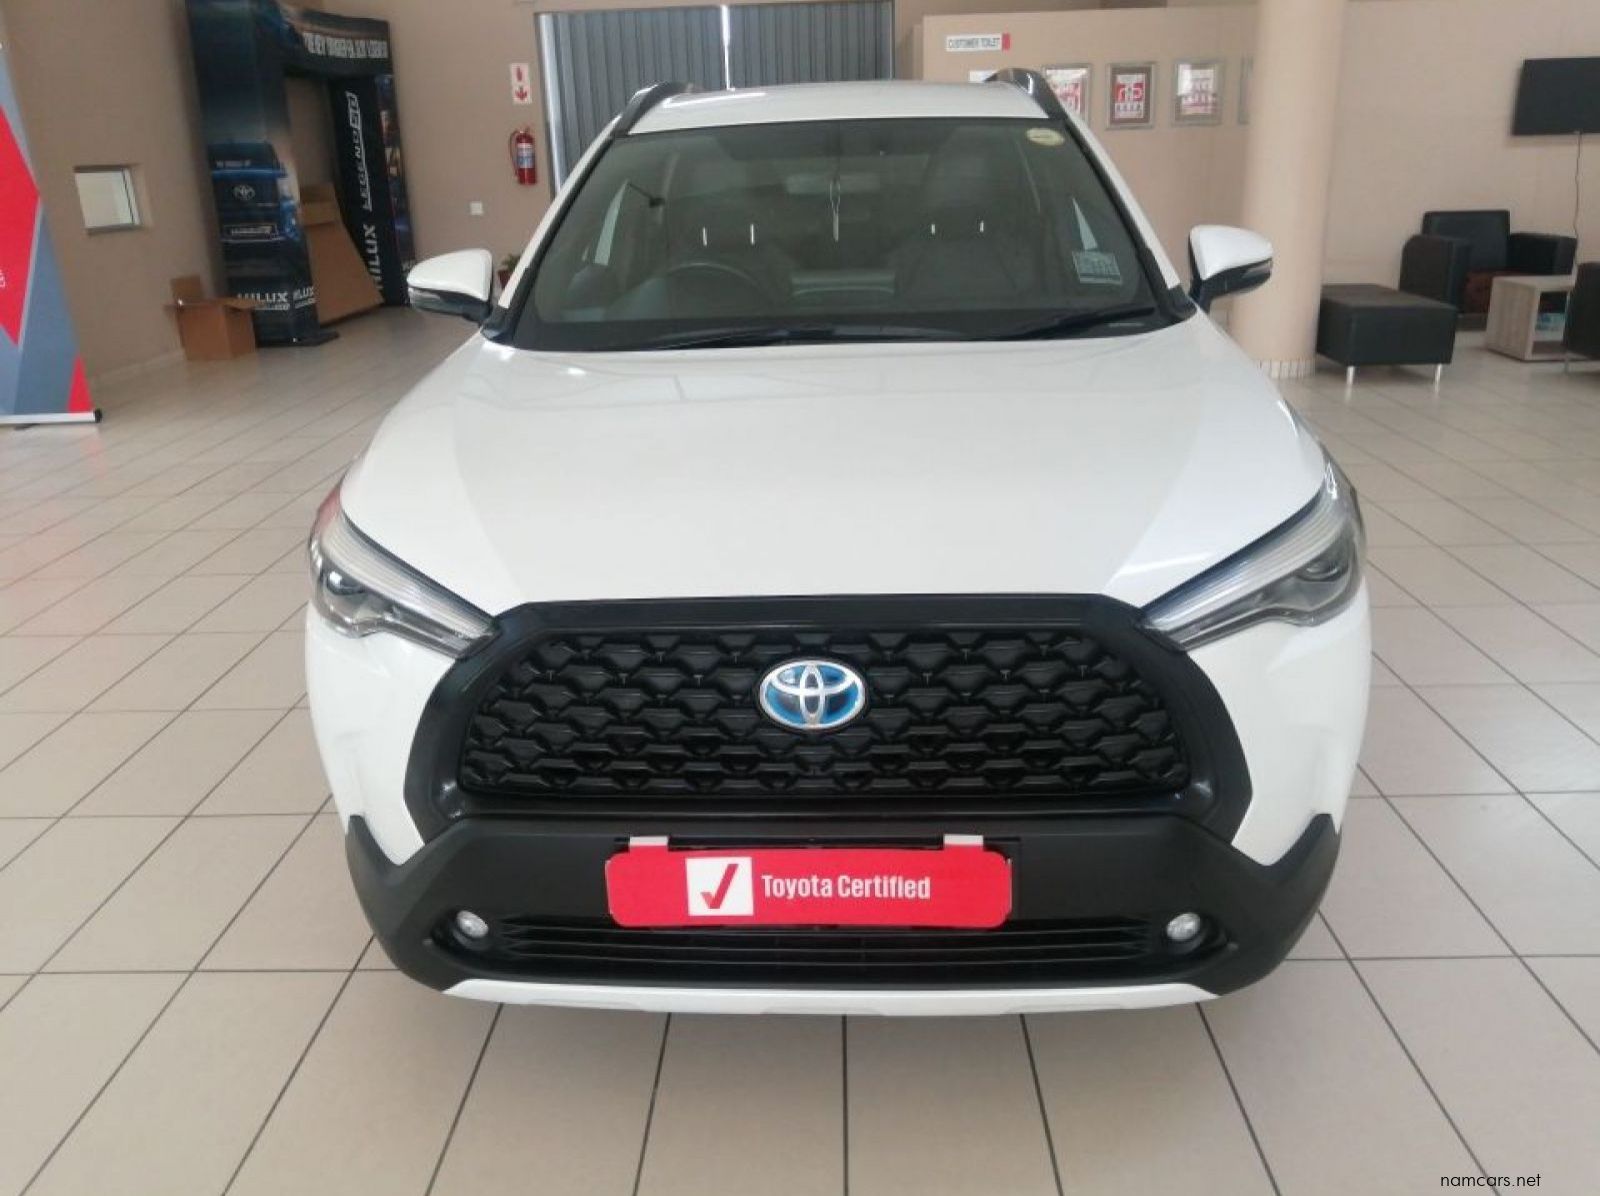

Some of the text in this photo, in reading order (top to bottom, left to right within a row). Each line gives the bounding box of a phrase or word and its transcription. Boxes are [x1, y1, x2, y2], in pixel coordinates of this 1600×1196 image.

[947, 37, 1000, 49] CUSTOMER TOILET
[761, 875, 931, 899] Toyota Certified
